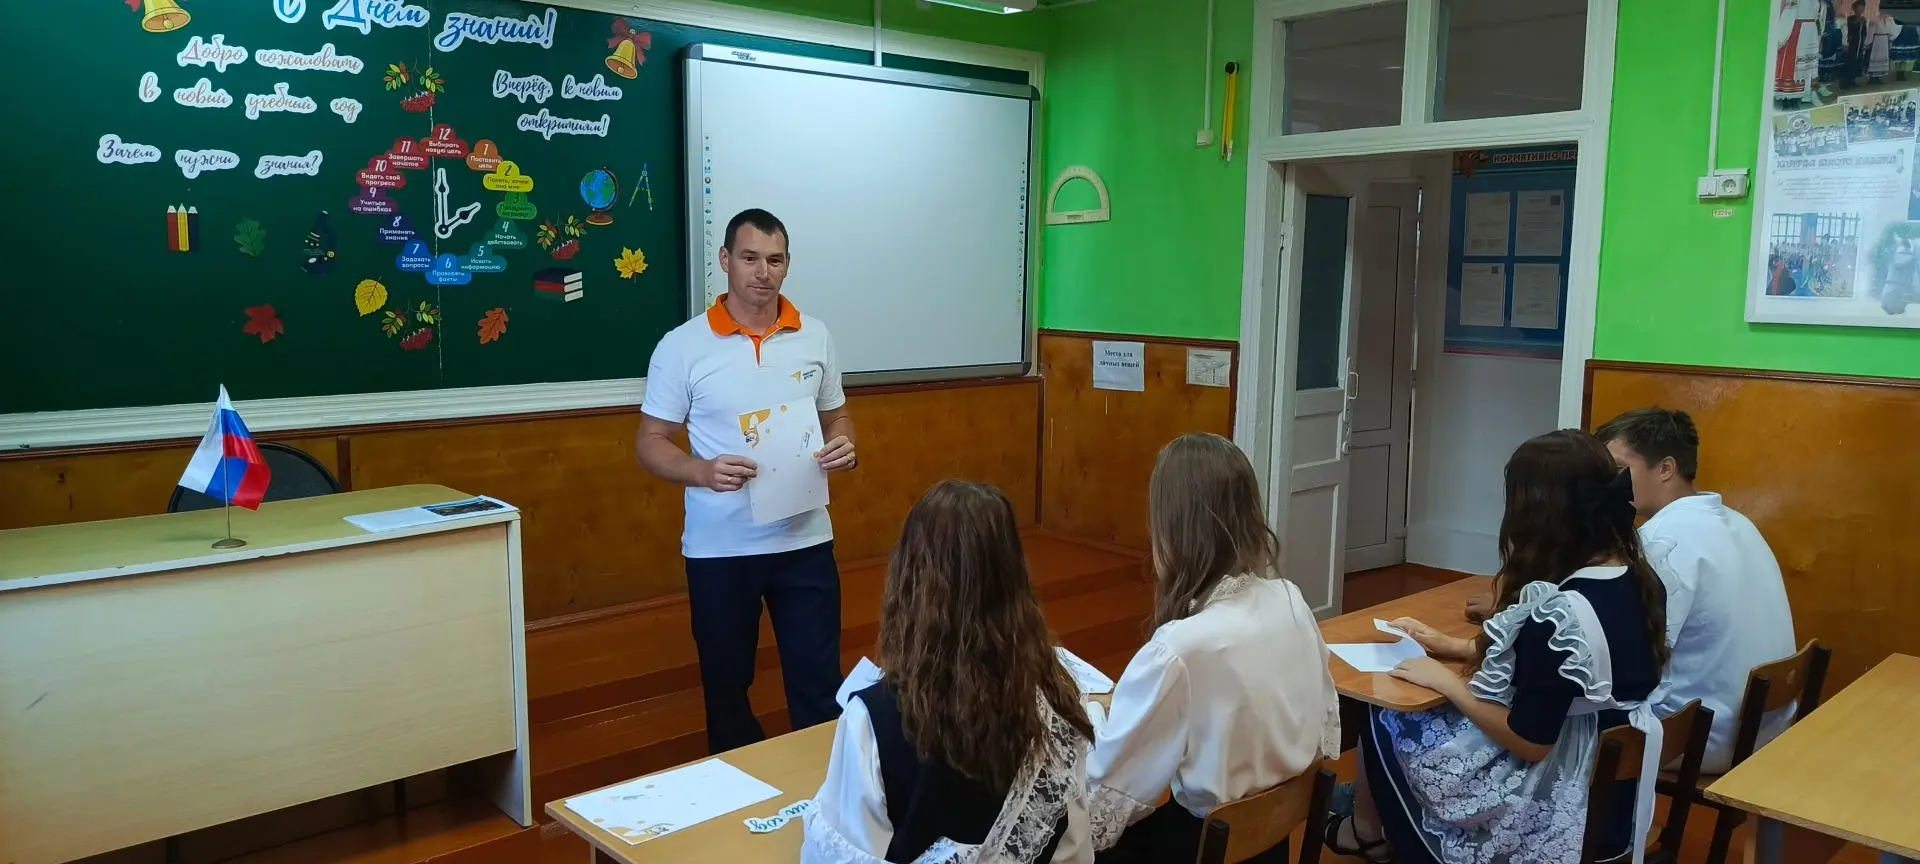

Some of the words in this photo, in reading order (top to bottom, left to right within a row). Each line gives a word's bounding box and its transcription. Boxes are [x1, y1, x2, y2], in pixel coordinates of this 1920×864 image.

[440, 12, 555, 46] знаний!
[182, 37, 243, 68] Добро
[258, 46, 361, 70] пожаловать
[496, 73, 551, 99] Вперёд,
[579, 77, 620, 97] новым
[142, 75, 156, 99] в
[176, 81, 229, 104] новый
[249, 86, 314, 116] учебный
[333, 102, 358, 120] год
[520, 110, 607, 137] открытиям!
[438, 128, 452, 141] 12
[102, 139, 156, 158] Зачем
[400, 140, 412, 154] 11
[425, 147, 446, 155] новую
[428, 140, 460, 150] Выбирать
[483, 143, 489, 156] 1
[388, 153, 424, 163] Завершать
[180, 154, 234, 174] нужны
[260, 154, 319, 176] знания?
[374, 159, 388, 172] 10
[504, 164, 512, 177] 2
[361, 172, 385, 181] Видеть
[369, 186, 377, 198] 9
[359, 199, 386, 207] Учиться
[362, 205, 392, 213] ошибках
[392, 215, 402, 228] 8
[502, 221, 509, 233] 4
[379, 227, 416, 236] Применять
[412, 243, 421, 255] 7
[487, 239, 524, 247] действовать
[477, 245, 485, 257] 5
[401, 255, 432, 263] Задавать
[444, 257, 452, 269] 6
[401, 262, 430, 270] вопросы
[460, 263, 502, 271] информацию
